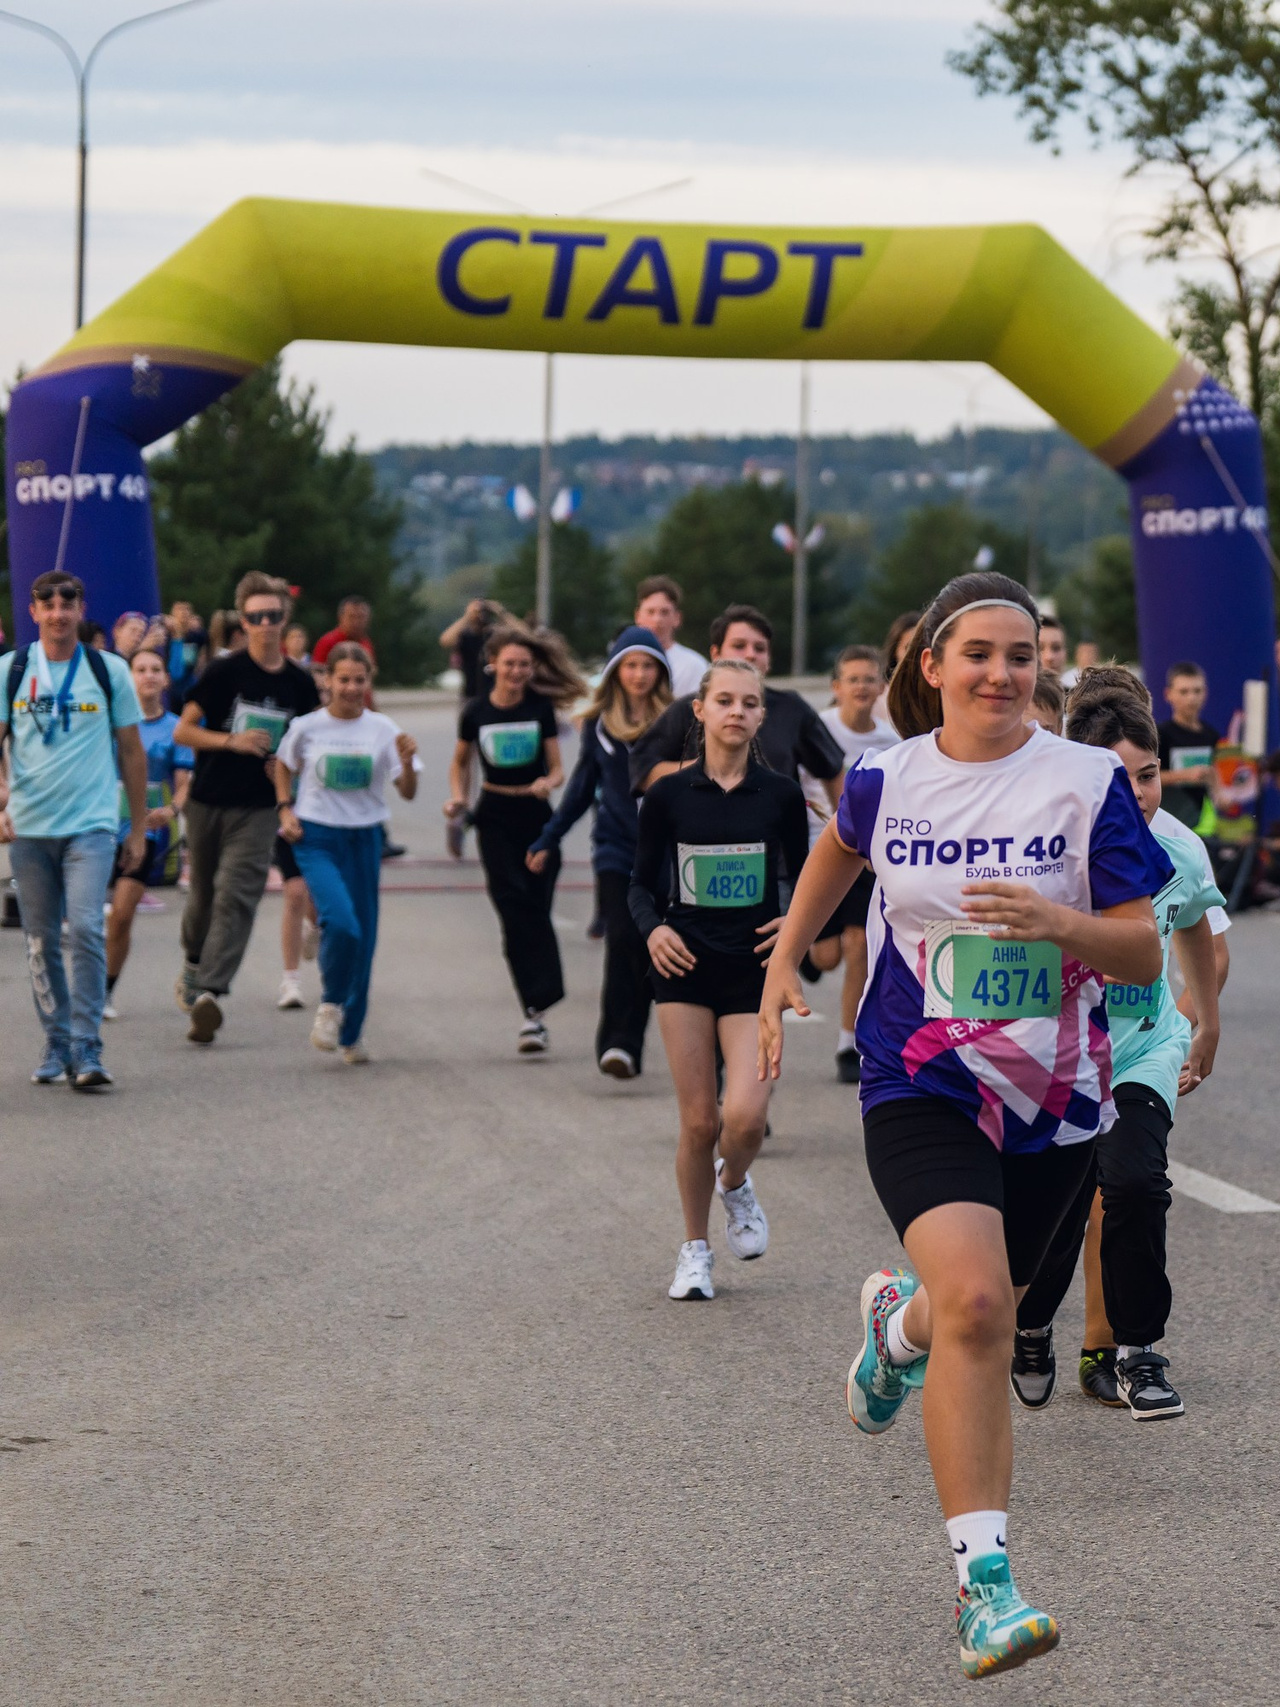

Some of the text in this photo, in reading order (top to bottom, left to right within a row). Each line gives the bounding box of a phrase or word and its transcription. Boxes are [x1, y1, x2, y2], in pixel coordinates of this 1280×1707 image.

[436, 226, 864, 331] СТАРТ
[16, 474, 116, 504] СПОРТ
[1142, 506, 1237, 537] СПОРТ
[885, 817, 932, 836] PRO
[885, 834, 1066, 866] СПОРТ 40
[716, 860, 746, 872] АЛИСА
[965, 862, 1064, 880] БУДЬ В СПОРТЕ!
[706, 874, 758, 899] 4820
[992, 946, 1027, 962] АННА
[971, 967, 1050, 1007] 4374
